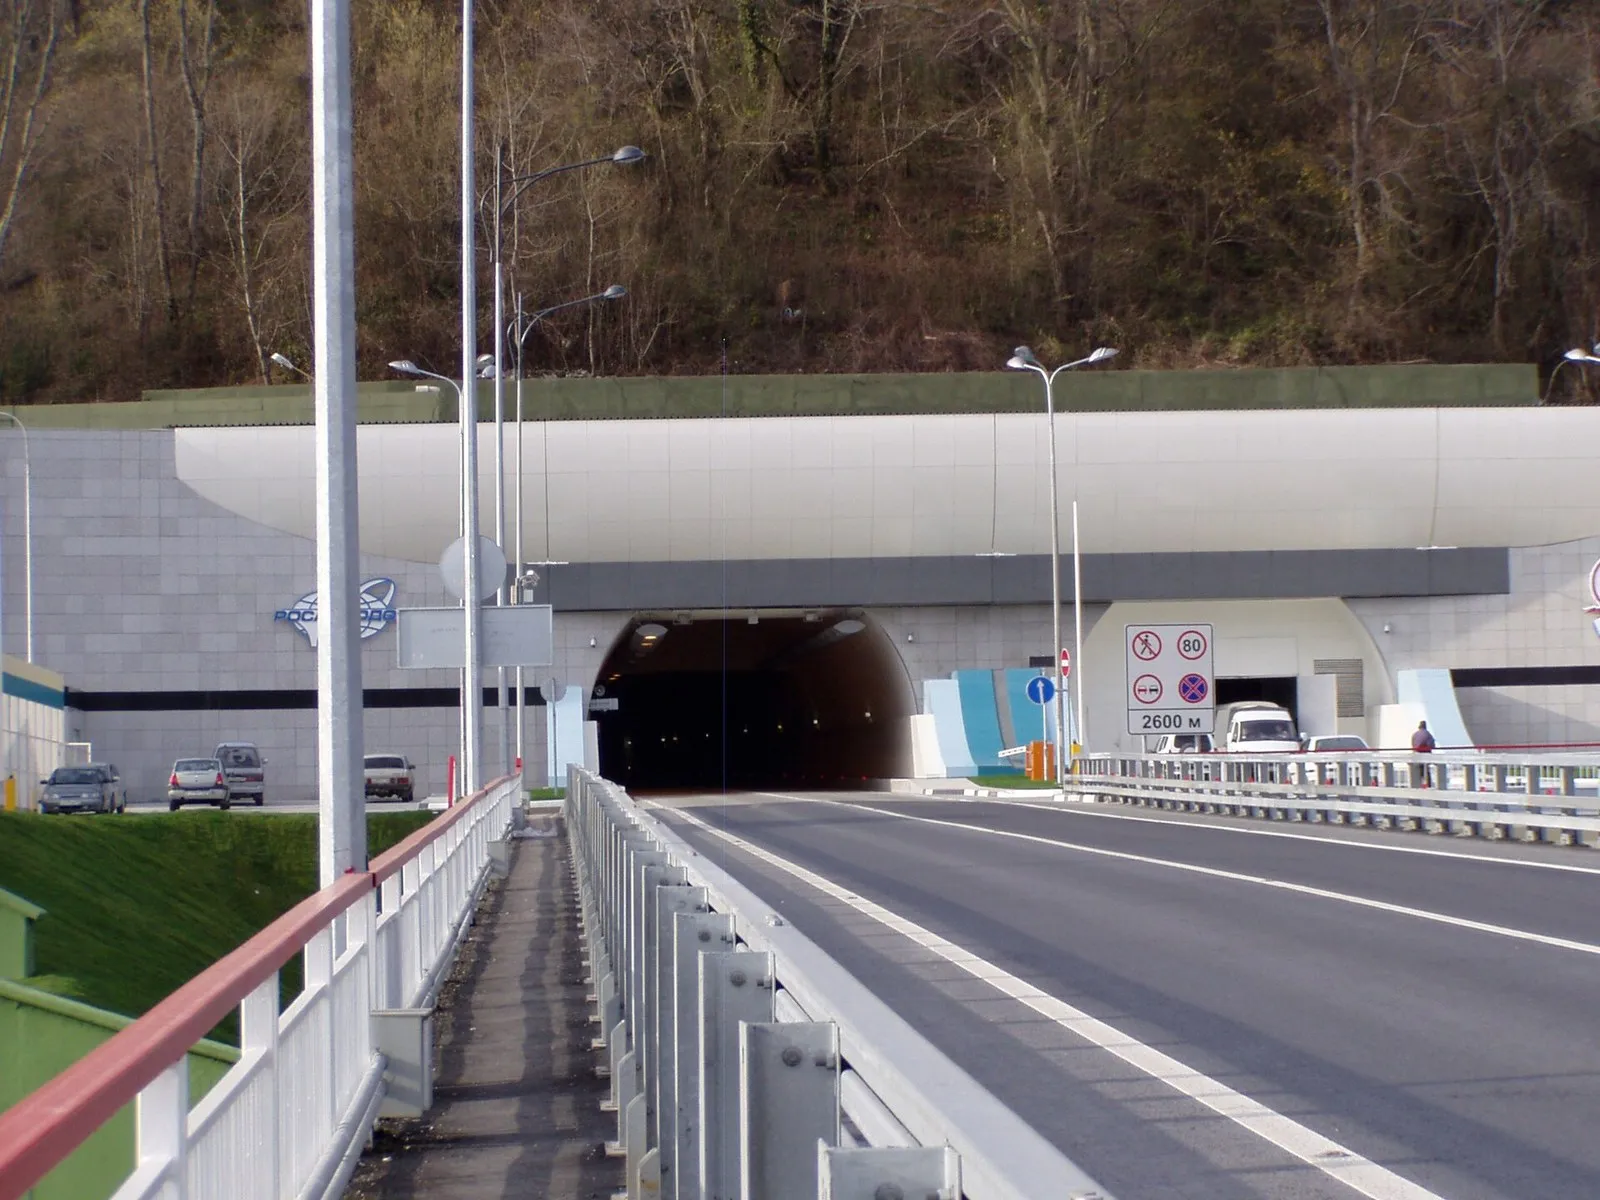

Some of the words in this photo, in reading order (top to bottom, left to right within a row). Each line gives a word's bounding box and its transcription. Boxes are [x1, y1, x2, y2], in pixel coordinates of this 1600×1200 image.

[274, 610, 397, 622] РОСОДО
[1183, 639, 1201, 652] 80
[1142, 714, 1182, 729] 2600
